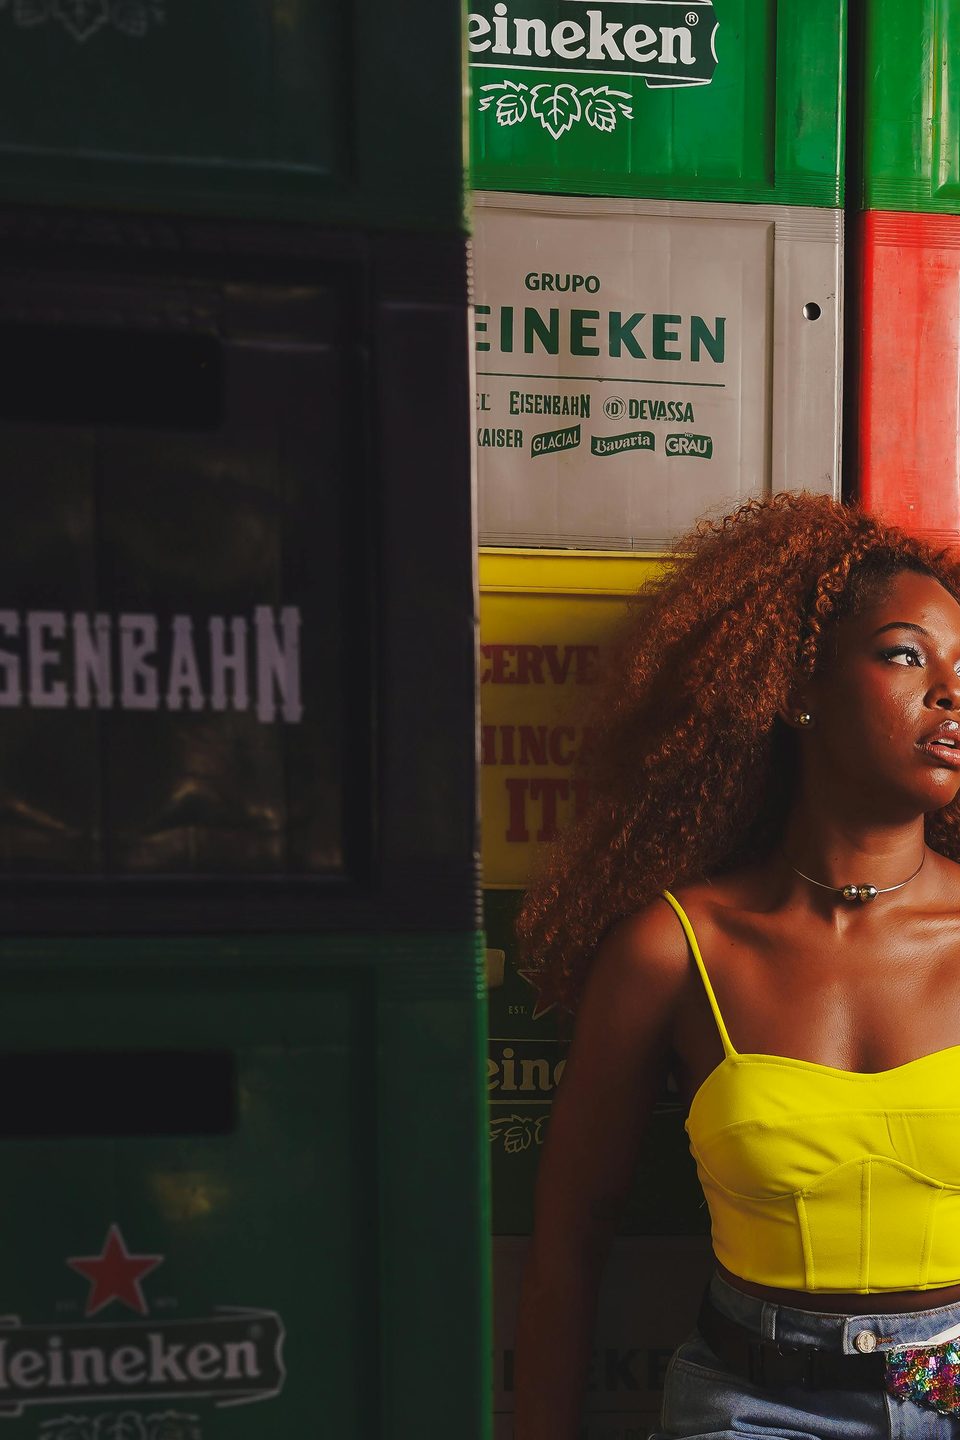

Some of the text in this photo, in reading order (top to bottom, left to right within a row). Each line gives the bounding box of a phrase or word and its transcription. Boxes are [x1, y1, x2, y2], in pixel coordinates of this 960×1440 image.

[525, 272, 601, 294] GRUPO
[509, 390, 591, 418] EISENBAHN
[628, 399, 695, 423] DEVASSA
[532, 430, 579, 452] GLACIAL
[594, 433, 651, 454] Bavaria
[666, 437, 708, 454] GRAU
